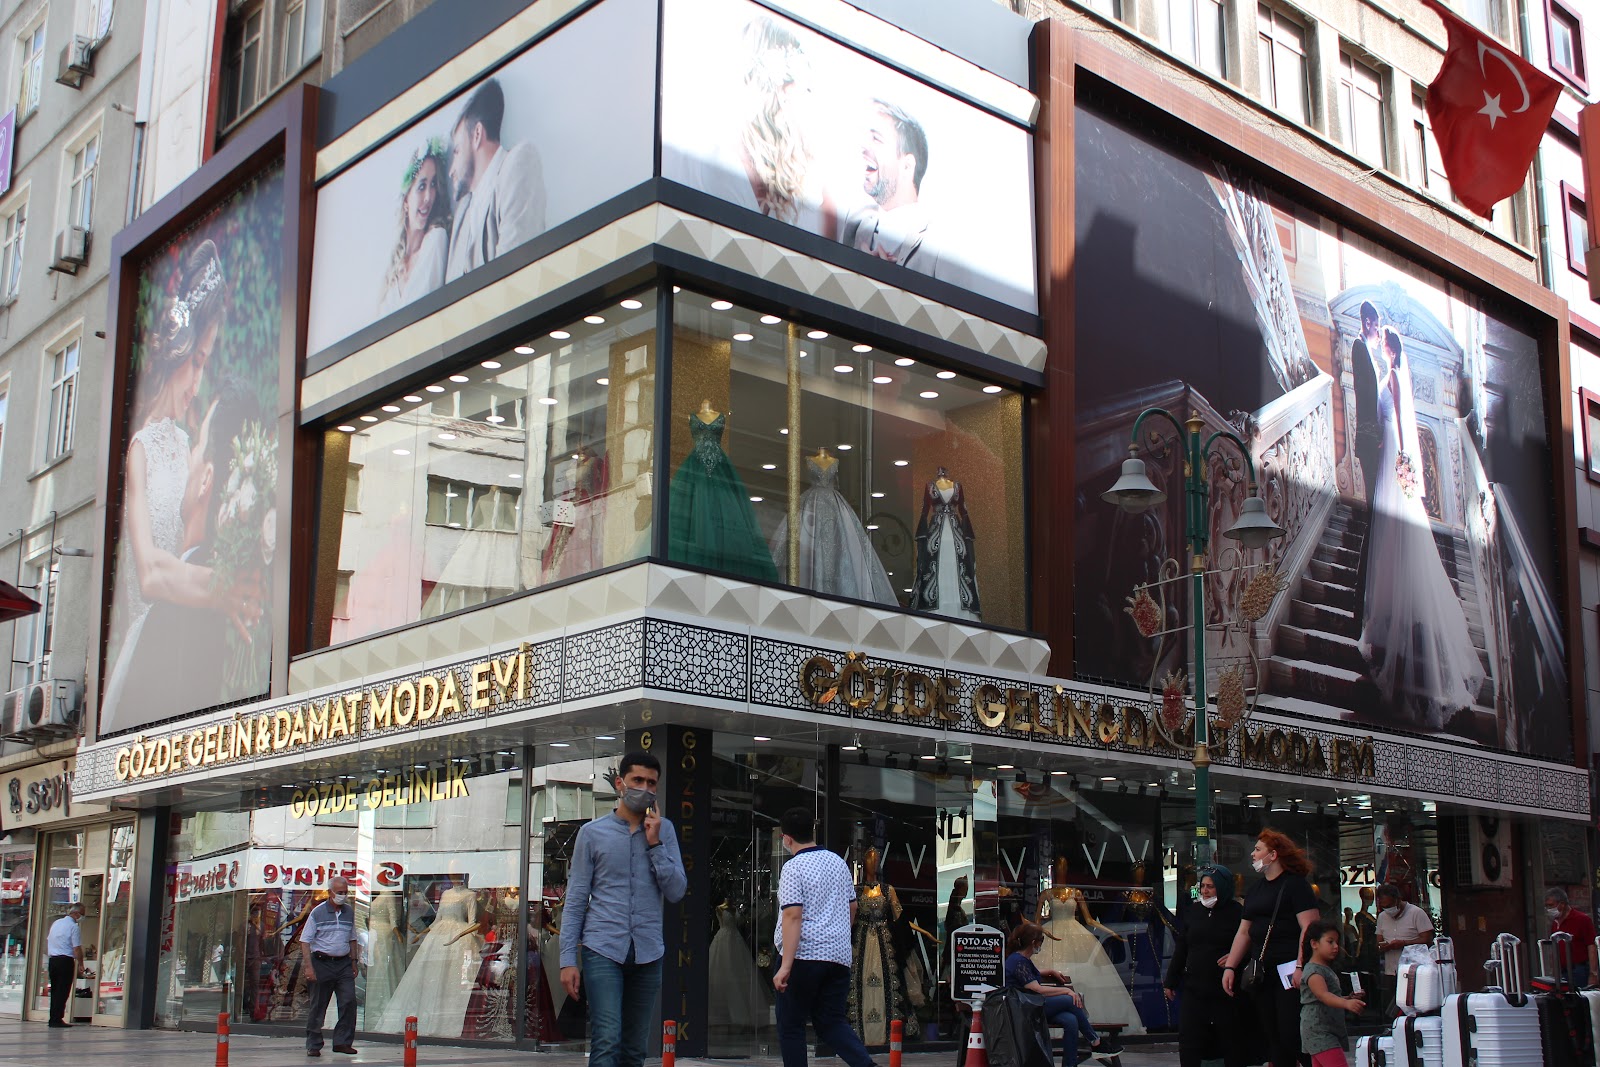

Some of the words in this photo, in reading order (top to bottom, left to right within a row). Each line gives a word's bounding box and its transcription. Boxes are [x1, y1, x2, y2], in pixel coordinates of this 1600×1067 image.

[115, 735, 184, 780] GÖZDE
[370, 669, 465, 731] MODA
[471, 642, 531, 709] EVİ
[800, 651, 962, 721] GÖZDE
[1240, 726, 1328, 771] MODA
[1333, 736, 1375, 778] EVİ
[290, 780, 359, 820] GÖZDE
[366, 759, 470, 810] GELİNLİK
[957, 937, 980, 946] FOTO
[981, 938, 1000, 948] AŞK
